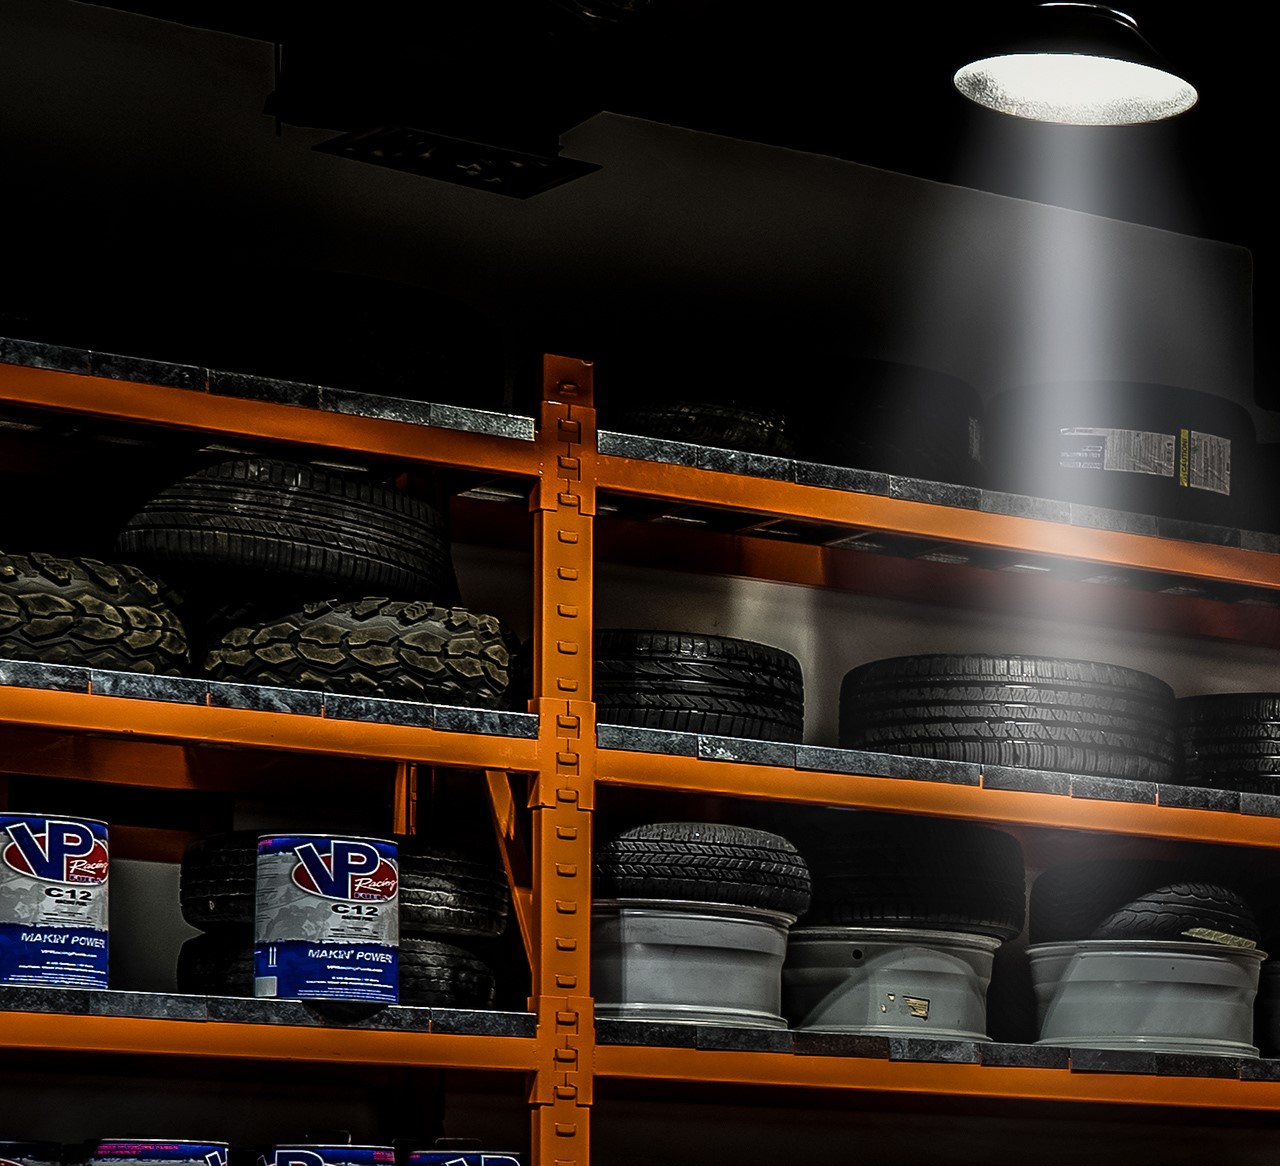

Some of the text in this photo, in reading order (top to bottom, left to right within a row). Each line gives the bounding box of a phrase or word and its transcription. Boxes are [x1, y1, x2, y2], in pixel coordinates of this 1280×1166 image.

[5, 820, 95, 882] VP
[69, 858, 109, 875] Racing
[294, 840, 380, 901] VP
[354, 877, 398, 892] Racing
[44, 887, 93, 901] C12
[331, 904, 379, 917] C12
